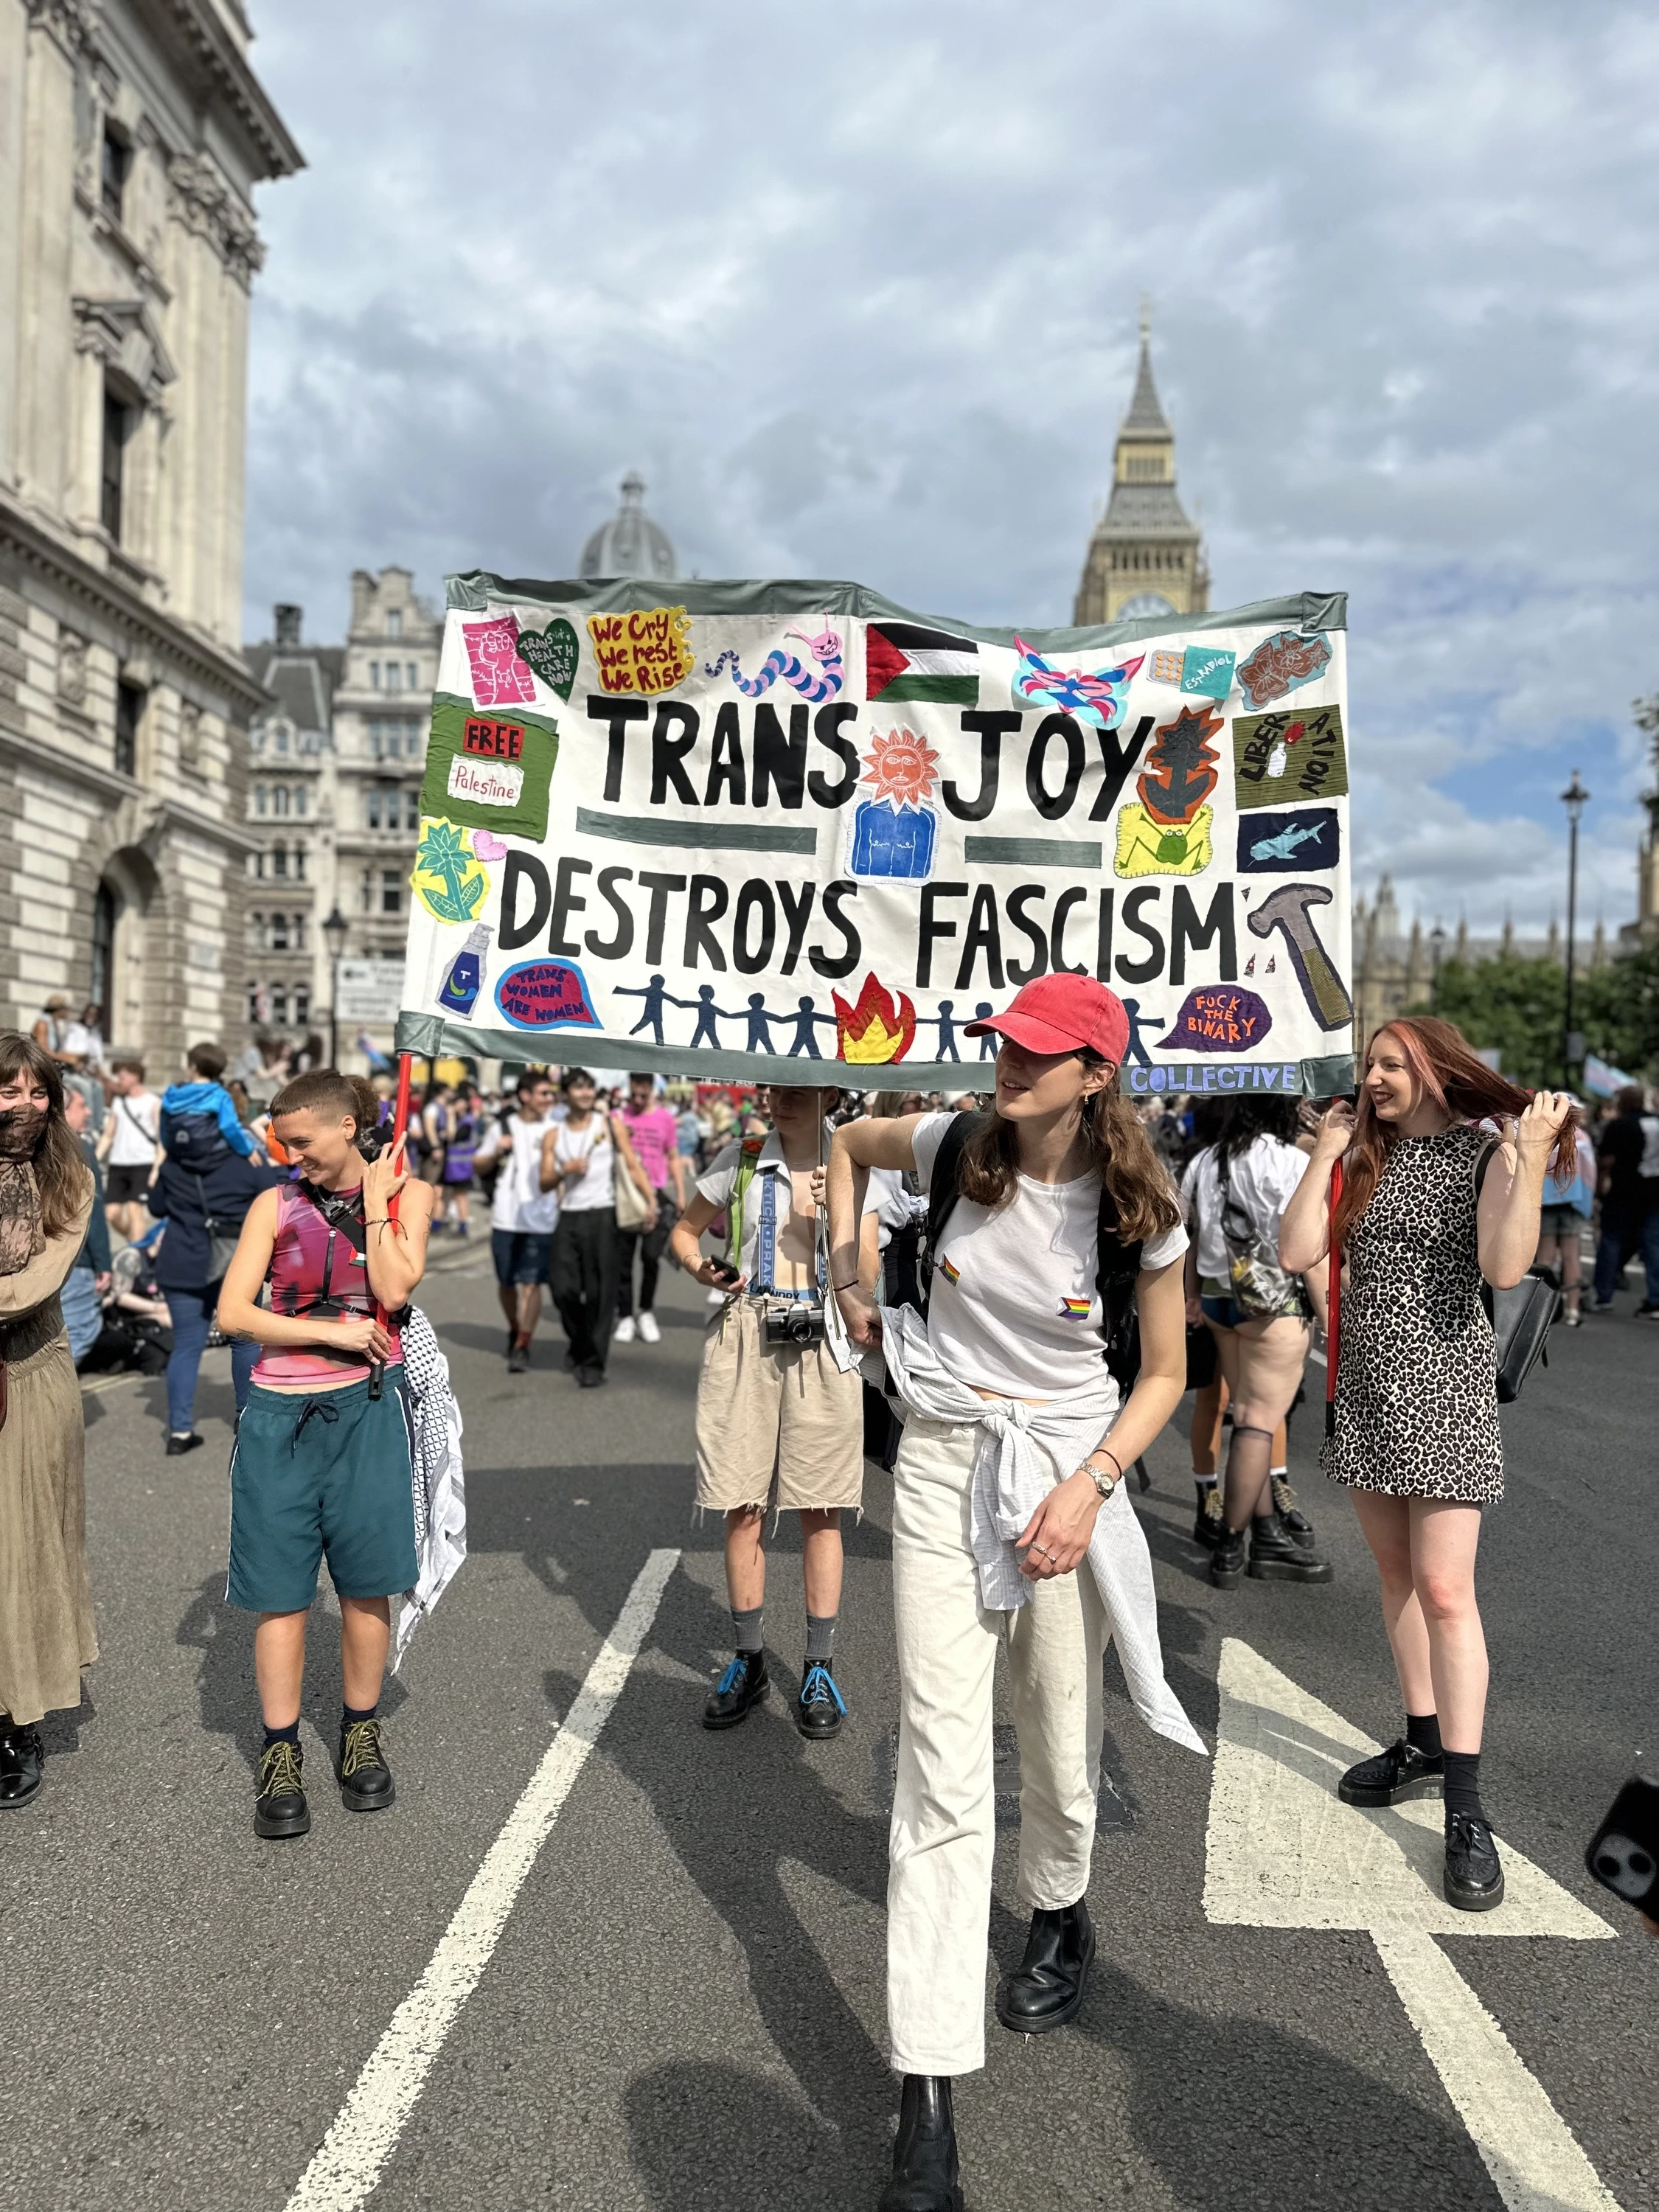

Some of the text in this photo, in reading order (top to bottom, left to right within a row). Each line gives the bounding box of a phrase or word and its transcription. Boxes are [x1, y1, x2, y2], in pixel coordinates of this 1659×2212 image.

[592, 613, 668, 643] We Cry
[519, 632, 554, 651] TRANS
[528, 644, 574, 662] HEALTH
[597, 636, 677, 667] We rest
[540, 658, 570, 675] CARE
[548, 670, 571, 686] NOW
[601, 663, 685, 692] We Rise
[1184, 654, 1232, 690] ESTRADIOL
[467, 724, 520, 758] FREE
[587, 695, 1155, 822] TRANS JOY
[455, 765, 515, 799] Palestine
[498, 849, 1238, 989] DESTROYS FASCISM
[517, 967, 568, 984] TRANS
[505, 984, 562, 998] WOMEN
[1196, 994, 1241, 1011] FUCK
[501, 998, 584, 1021] ARE WOMEN
[1204, 1009, 1234, 1022] THE
[1188, 1017, 1256, 1043] BINARY
[1130, 1065, 1296, 1093] COLLECTIVE
[749, 1284, 801, 1300] LANDRY
